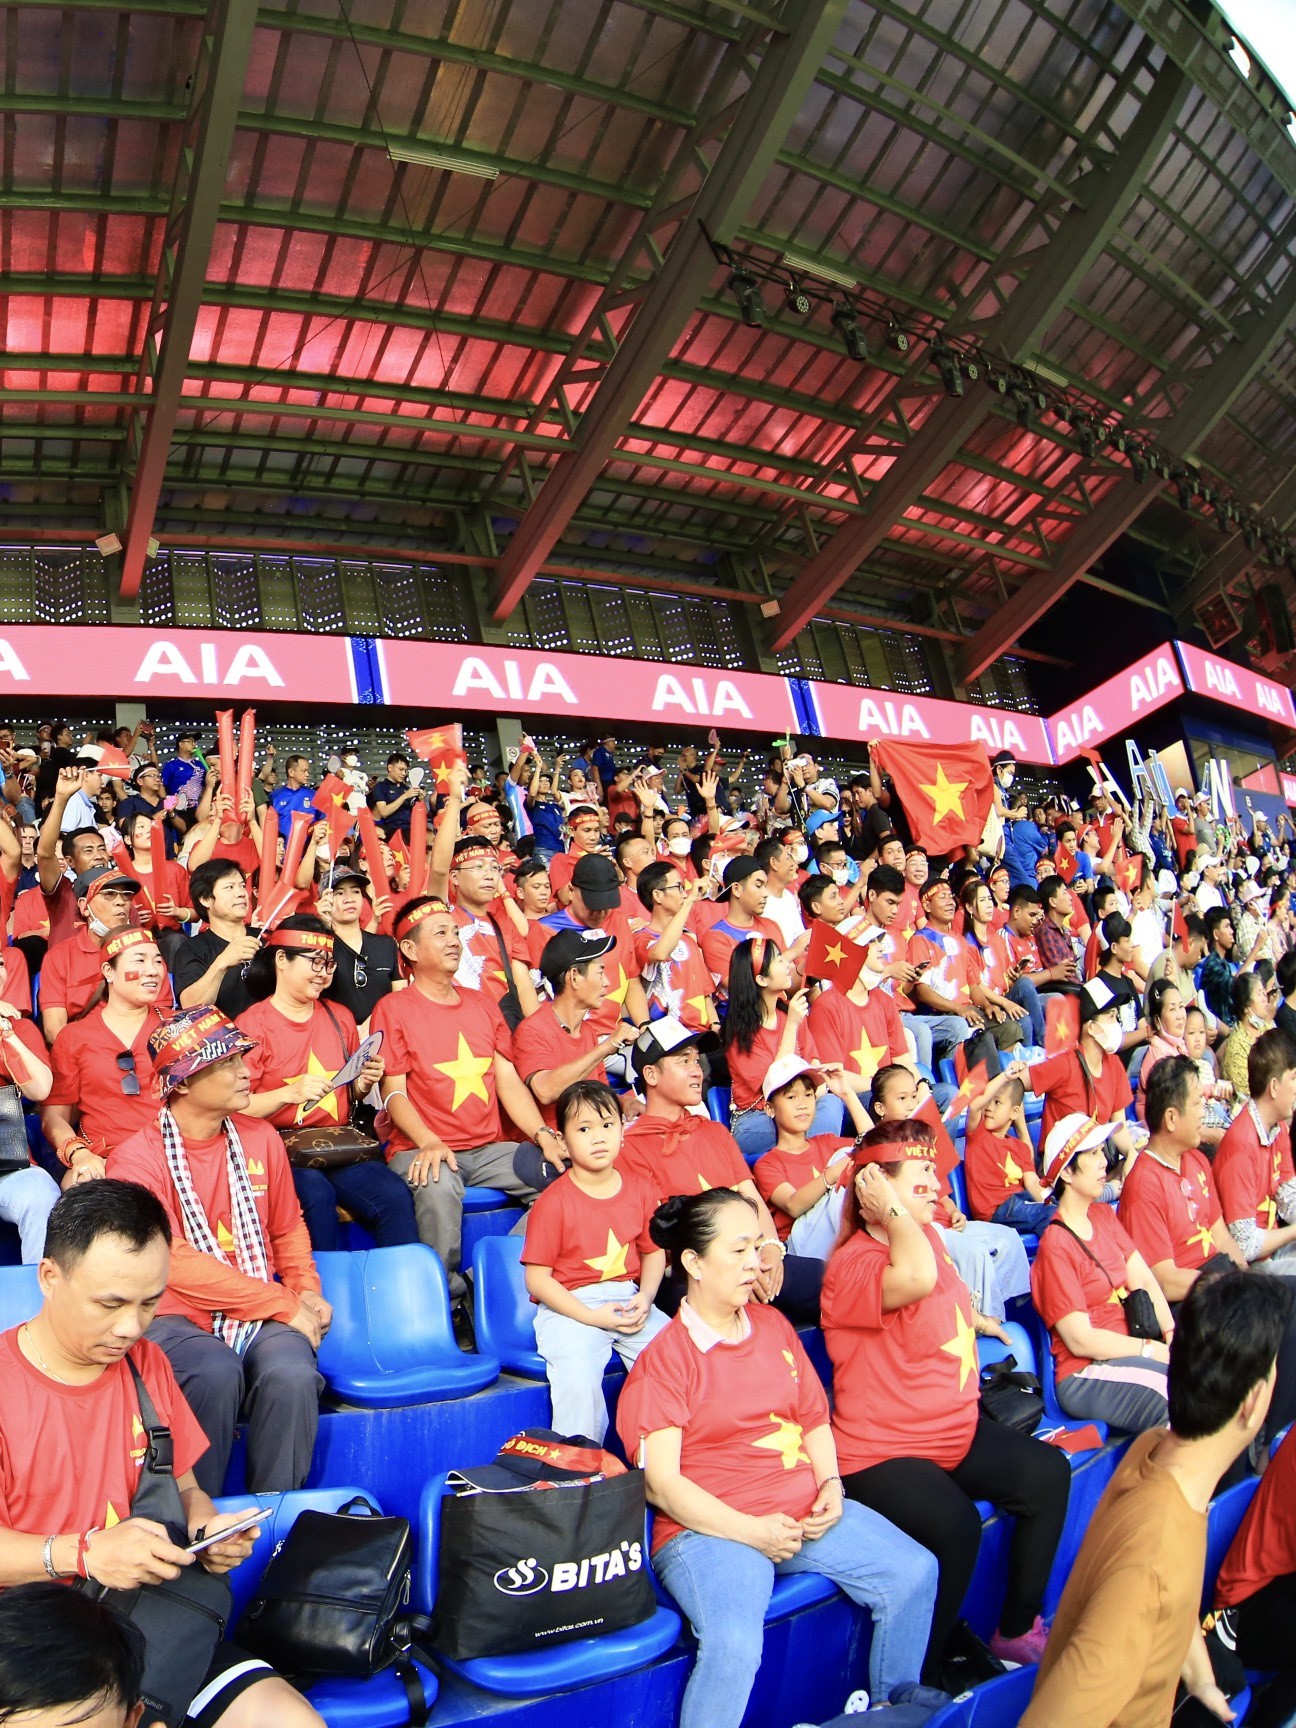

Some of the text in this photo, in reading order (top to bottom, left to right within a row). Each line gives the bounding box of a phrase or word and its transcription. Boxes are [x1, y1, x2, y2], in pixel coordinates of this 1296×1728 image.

[134, 641, 286, 687] AIA
[452, 656, 579, 704] AIA
[1204, 659, 1243, 700] AIA
[651, 673, 755, 719] AIA
[1129, 657, 1179, 712] AIA
[1256, 681, 1286, 717] AIA
[858, 697, 931, 739] AIA
[970, 714, 1027, 752] AIA
[1057, 705, 1104, 755] AIA
[455, 848, 485, 864] VIỆT NAM
[408, 908, 423, 923] TÔI
[106, 931, 144, 955] VIỆT NAM
[301, 933, 317, 945] TÔI
[171, 1012, 222, 1052] VIỆT NAM
[905, 1144, 927, 1159] VIỆT
[1064, 1134, 1081, 1154] VIỆT
[515, 1440, 549, 1457] ĐỊCH
[534, 1617, 605, 1639] www.bitas.com.vn
